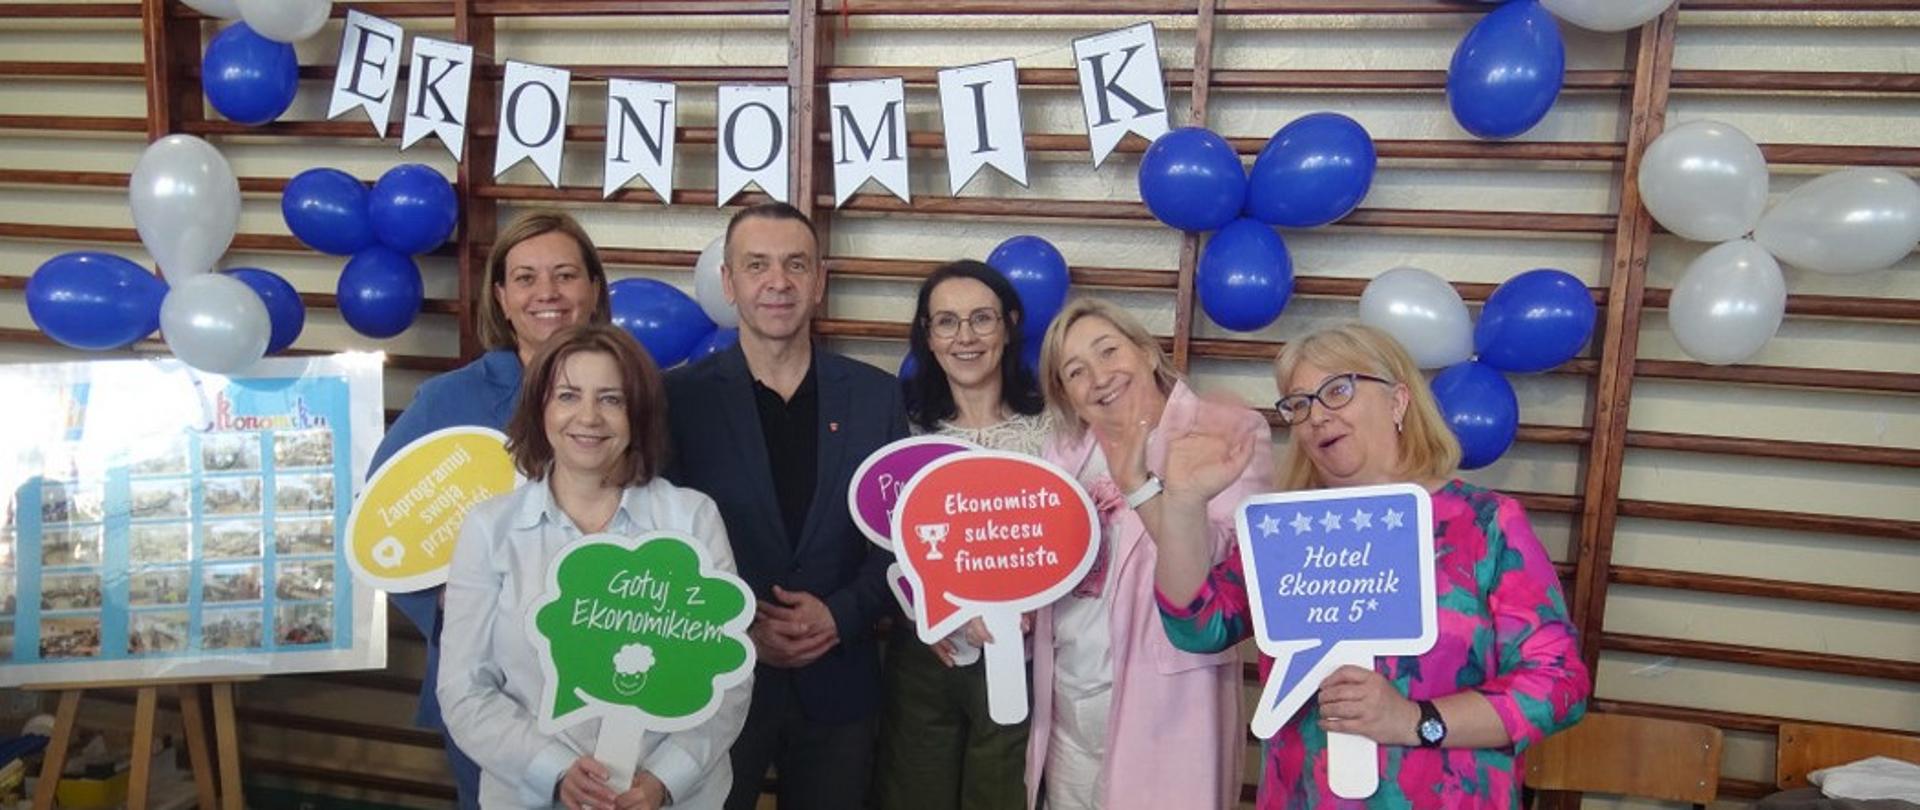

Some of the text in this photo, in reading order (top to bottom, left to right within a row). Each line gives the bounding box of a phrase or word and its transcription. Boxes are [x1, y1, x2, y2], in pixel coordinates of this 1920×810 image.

[340, 23, 1165, 171] EKONOMIK
[378, 443, 472, 528] Zaprogramuj
[420, 485, 465, 525] swoją
[944, 487, 1061, 515] Ekonomista
[964, 520, 1043, 543] sukcesu
[954, 546, 1058, 573] finansista
[1303, 542, 1371, 569] Hotel
[608, 569, 672, 612] Gotuj
[1278, 570, 1399, 596] Ekonomik
[572, 598, 723, 643] Ekonomikiem
[1307, 606, 1339, 623] na
